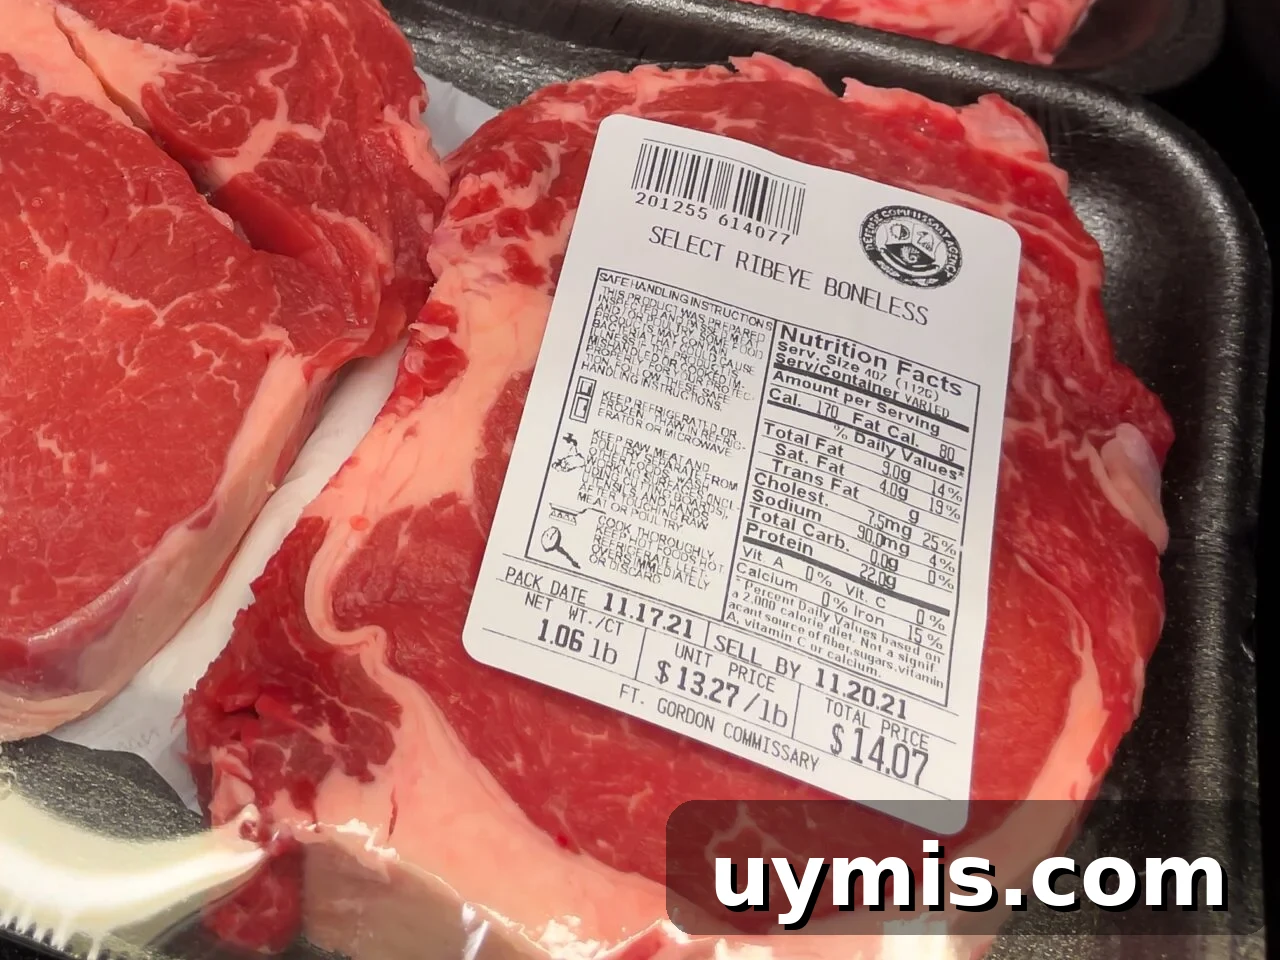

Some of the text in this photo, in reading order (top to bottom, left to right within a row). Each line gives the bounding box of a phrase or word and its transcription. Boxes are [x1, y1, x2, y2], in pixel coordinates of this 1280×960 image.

[635, 191, 790, 245] 201255 614077
[648, 225, 928, 325] SELECT RIBEYE BONELESS
[630, 280, 689, 304] HANDLING
[690, 296, 775, 332] INSTRUCTIONS
[777, 340, 820, 361] Serv.
[825, 353, 860, 373] Size
[780, 321, 964, 396] Nutrition Facts
[772, 366, 942, 437] Amount per Serving
[775, 352, 950, 419] Serv/Container VARIED
[763, 421, 810, 446] Total
[814, 436, 844, 458] Fat
[879, 460, 912, 484] 9.0g
[768, 387, 955, 463] Cal. 170 Fat Cal. 80
[852, 431, 897, 459] Daily
[753, 471, 828, 506] Cholest.
[771, 458, 824, 486] Trans
[830, 477, 859, 500] Fat
[774, 442, 808, 466] Sat.
[816, 454, 845, 476] Fat
[877, 479, 909, 503] 4.0g
[749, 504, 796, 533] Total
[800, 522, 849, 552] Carb.
[752, 488, 822, 522] Sodium
[745, 521, 813, 556] Protein
[504, 566, 692, 639] PACK DATE 11.17.21
[736, 561, 885, 627] Calcium Iron
[772, 557, 784, 569] A
[845, 582, 868, 602] Vit.
[874, 595, 886, 609] C
[524, 591, 624, 636] NET WT./CT
[764, 613, 805, 634] source
[807, 630, 821, 641] of
[780, 607, 826, 630] calorie
[860, 636, 882, 653] Not
[796, 599, 832, 623] Daily
[833, 612, 879, 640] Values
[880, 631, 921, 656] based
[924, 651, 941, 664] on
[537, 618, 618, 665] 1.06 lb
[674, 642, 776, 693] UNIT PRICE
[744, 618, 792, 642] vitamin
[826, 650, 881, 678] calcium.
[713, 634, 906, 720] SELL BY 11.20.21
[619, 682, 819, 771] FT. GORDON COMMISSARY
[825, 696, 929, 752] TOTAL PRICE
[830, 723, 928, 785] $14.07
